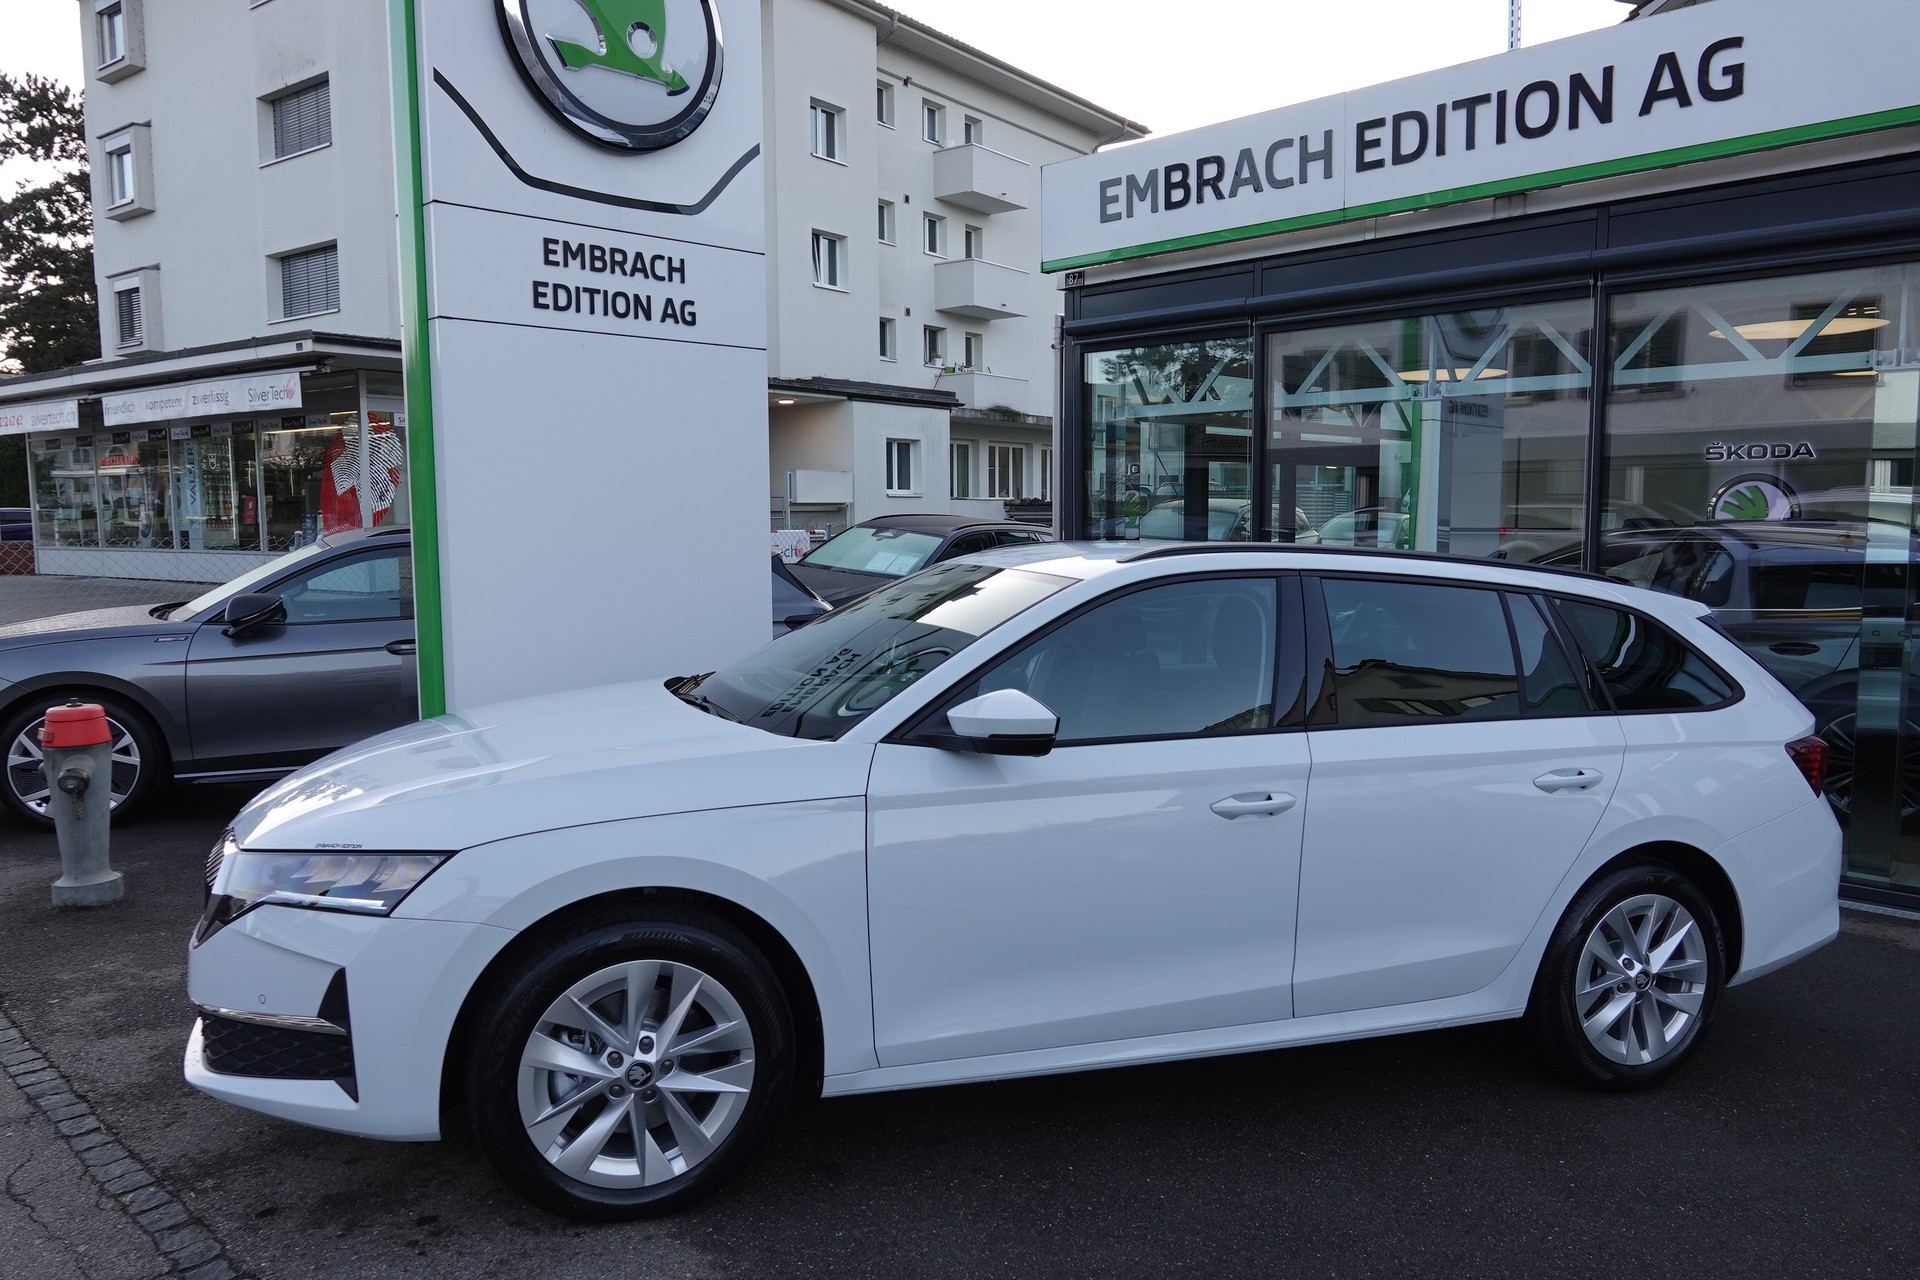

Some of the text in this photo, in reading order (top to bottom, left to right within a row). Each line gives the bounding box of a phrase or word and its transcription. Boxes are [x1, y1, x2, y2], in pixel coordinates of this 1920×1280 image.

[1099, 36, 1745, 224] EMBRACH EDITION AG
[542, 237, 686, 284] EMBRACH
[1068, 273, 1079, 285] 87
[532, 280, 697, 327] EDITION AG
[31, 406, 75, 426] silvertech.ch
[104, 400, 136, 416] freundlich
[145, 397, 183, 412] kompetent
[247, 384, 289, 403] SilverTech
[1704, 441, 1816, 461] ŠKODA
